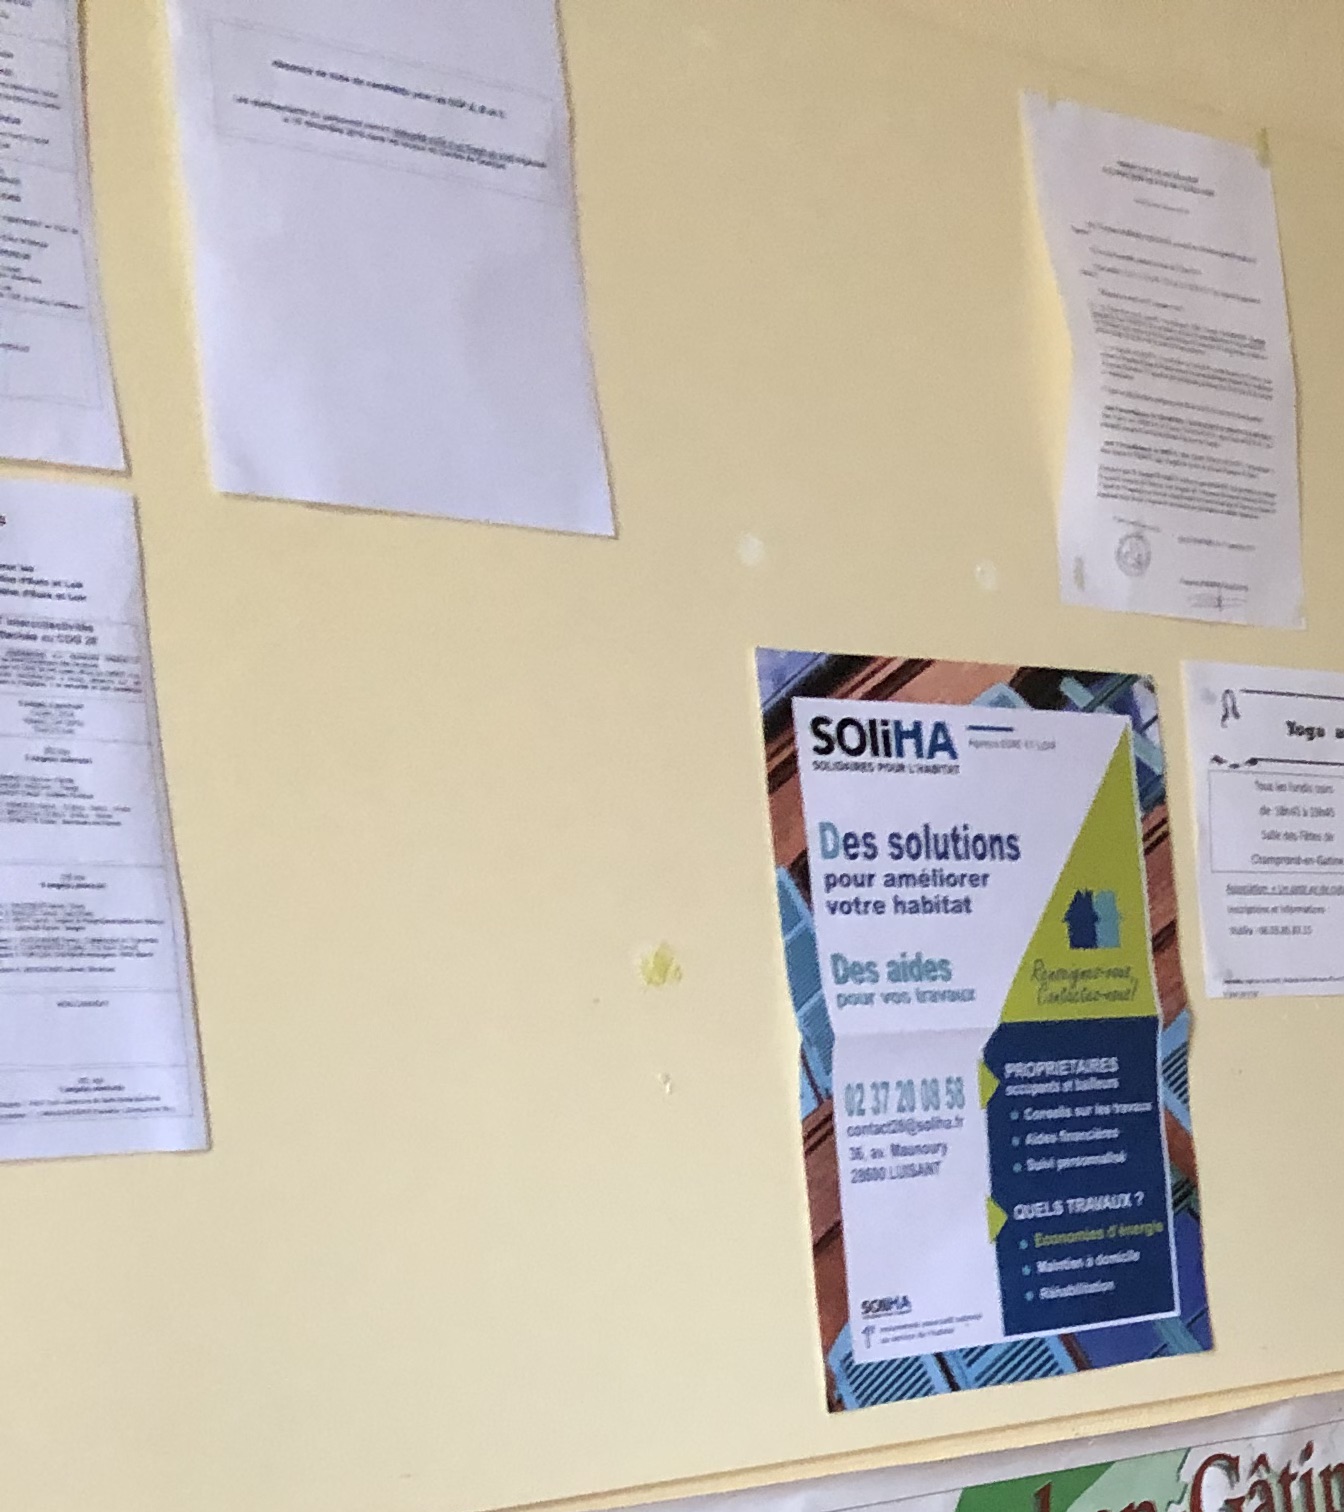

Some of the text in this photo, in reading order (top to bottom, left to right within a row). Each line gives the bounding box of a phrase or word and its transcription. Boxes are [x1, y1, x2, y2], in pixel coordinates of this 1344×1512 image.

[1285, 720, 1326, 742] Yoga
[819, 821, 1021, 862] Des solutions
[824, 868, 991, 893] pour améliorer
[825, 894, 974, 916] votre habitat
[830, 951, 953, 985] Des aides
[836, 992, 876, 1009] pour
[844, 1081, 866, 1118] 02
[870, 1080, 889, 1117] 37
[1013, 1199, 1064, 1221] QUELS
[1066, 1192, 1133, 1215] TRAVAUX
